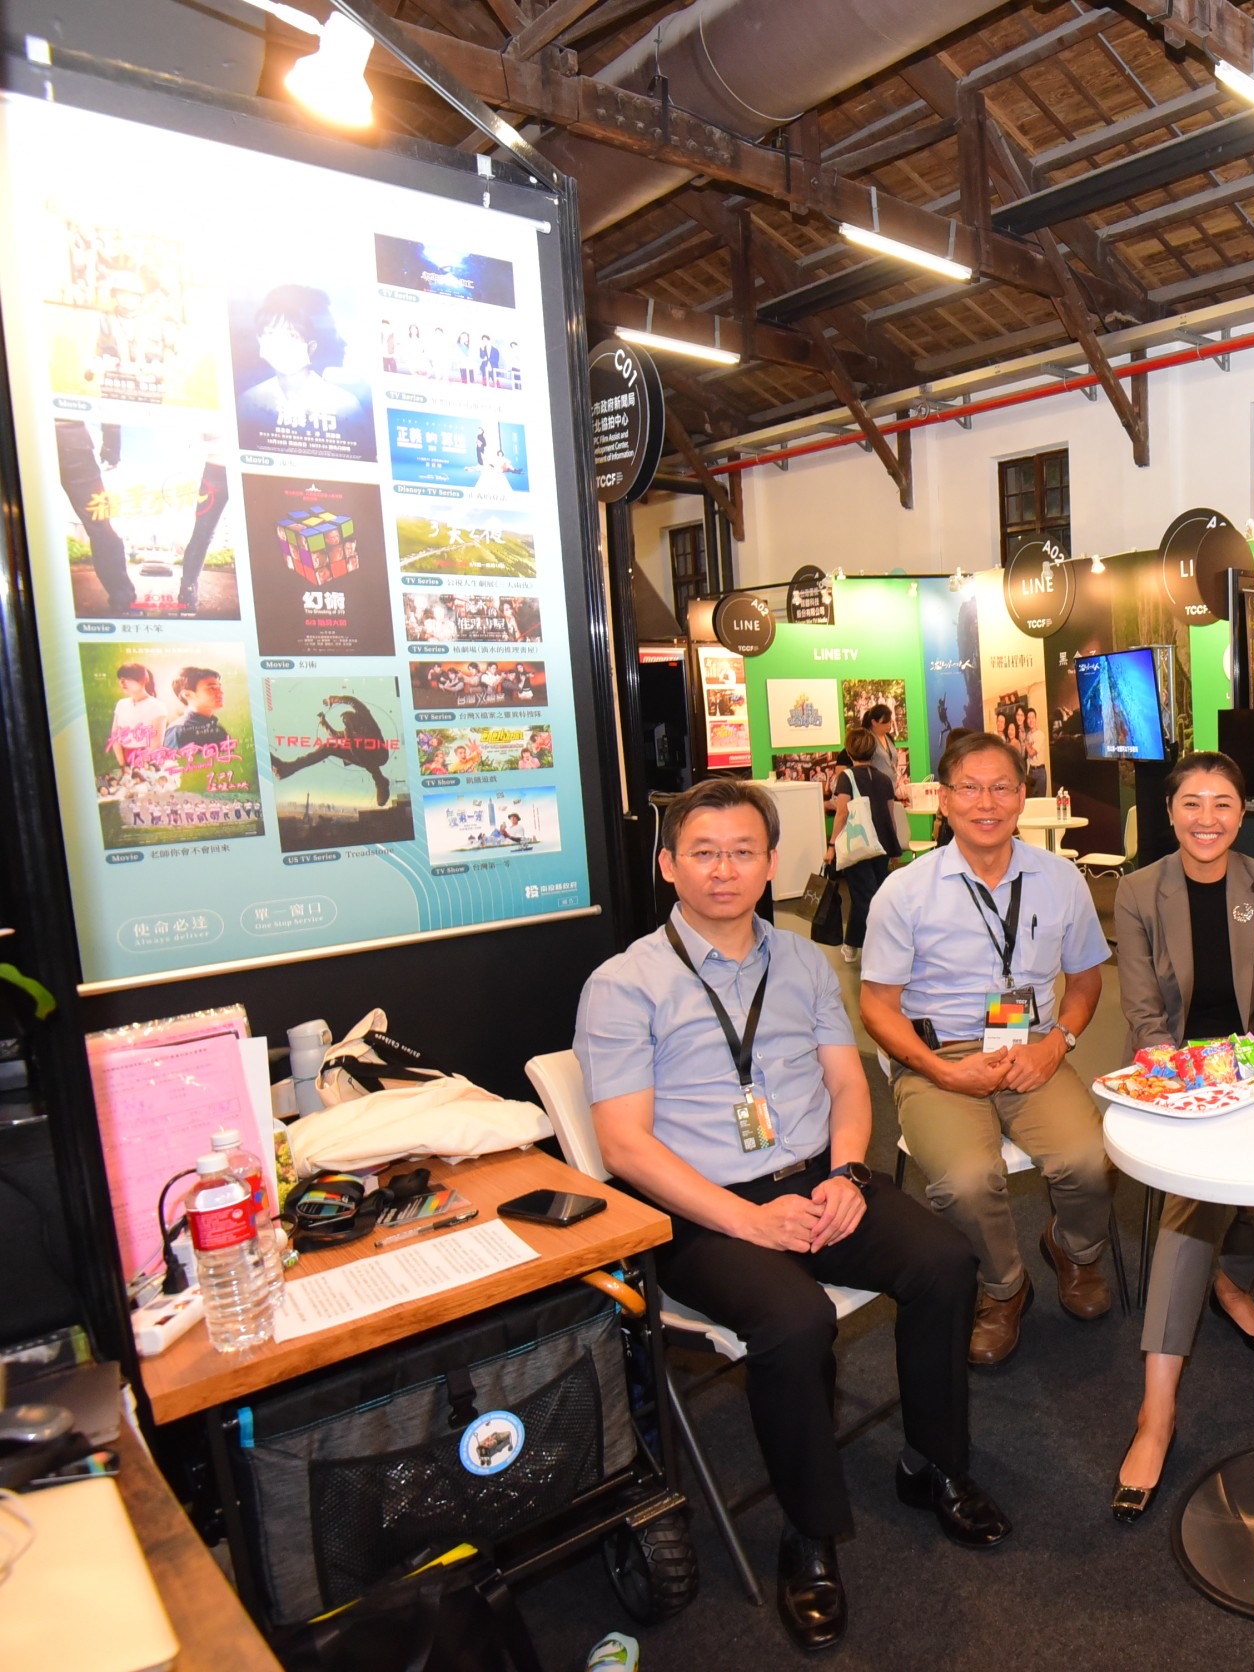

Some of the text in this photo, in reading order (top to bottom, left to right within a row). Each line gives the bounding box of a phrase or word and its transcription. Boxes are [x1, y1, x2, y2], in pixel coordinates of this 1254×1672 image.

[614, 349, 638, 388] C01
[389, 391, 424, 402] TV Series
[58, 399, 88, 412] Movie
[592, 412, 629, 433] 北協拍中心
[244, 455, 271, 466] Movie
[596, 473, 616, 488] TCCF
[428, 488, 438, 496] TV
[440, 489, 461, 499] Series
[1042, 540, 1064, 566] A02
[1180, 559, 1194, 577] LI
[405, 576, 439, 586] TV Series
[1022, 577, 1054, 595] LINE
[302, 591, 345, 610] 幻術
[751, 598, 769, 617] A02
[82, 623, 111, 634] Movie
[734, 619, 760, 631] LINE
[1027, 619, 1046, 628] TCCF
[412, 645, 445, 654] TV Series
[813, 648, 859, 661] LINE TV
[266, 660, 290, 670] Movie
[298, 660, 317, 670] 幻術
[419, 712, 453, 721] TV Series
[275, 735, 400, 750] TREADSTONE
[426, 778, 457, 787] TV Show
[111, 852, 139, 863] Movie
[151, 844, 230, 859] 老師你會不會回來
[345, 848, 394, 859] Treadstone
[287, 853, 337, 864] US TV Series
[435, 866, 466, 875] TV Show
[540, 881, 577, 892] 南投縣政府
[255, 902, 321, 921] 單一窗口
[133, 915, 208, 938] 使命必達
[255, 916, 324, 930] One Stop Service
[135, 929, 209, 946] Always deliver
